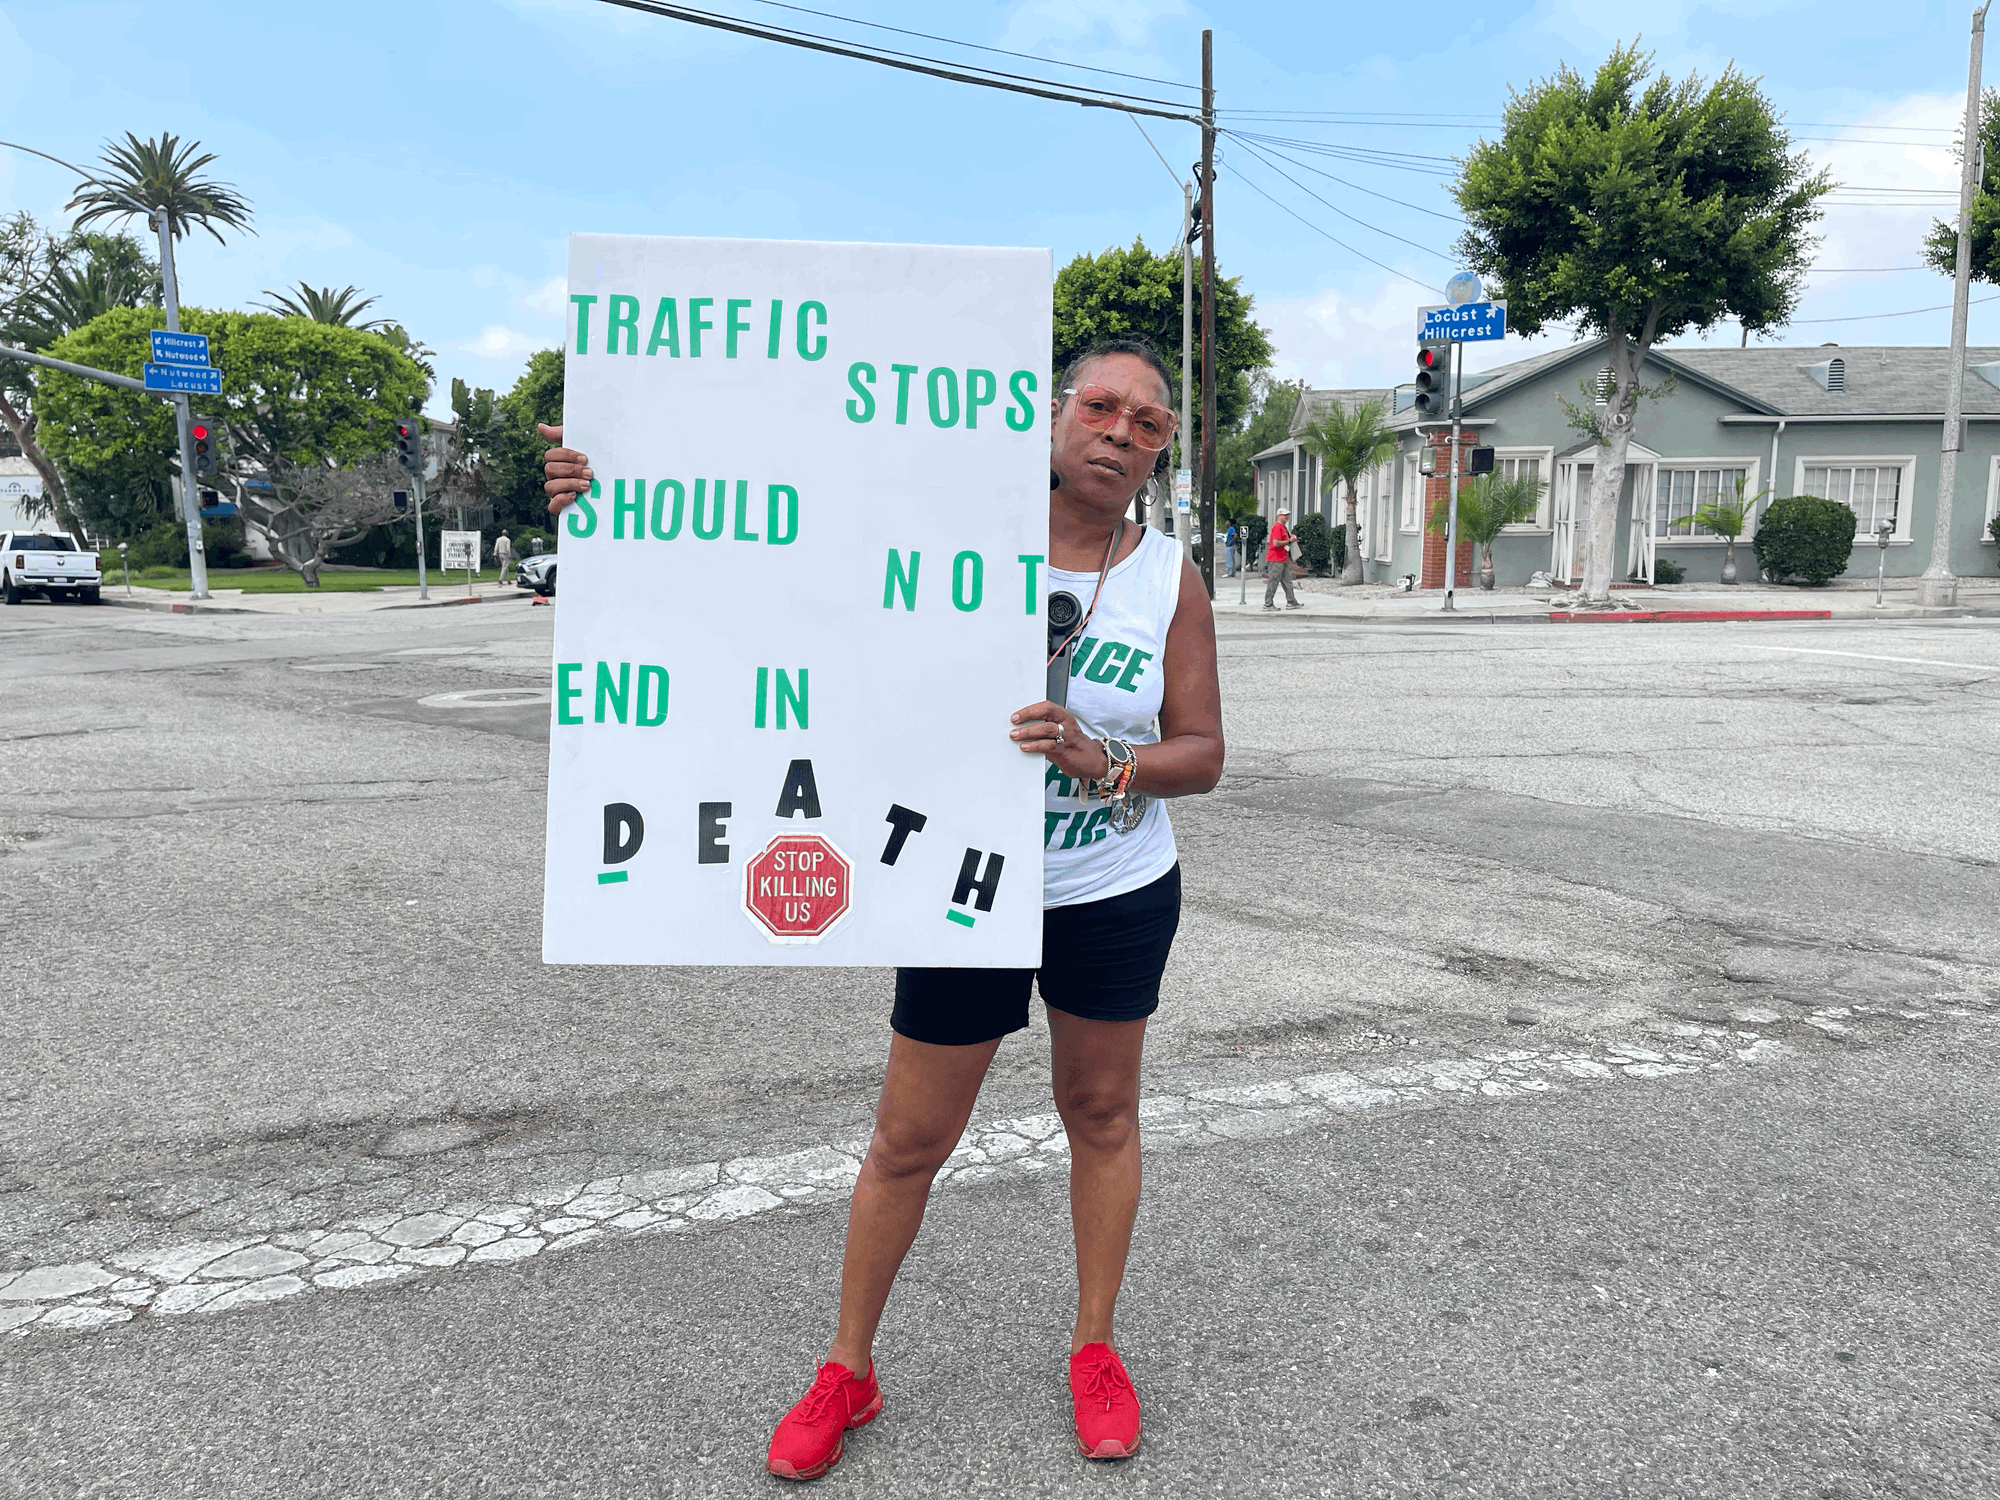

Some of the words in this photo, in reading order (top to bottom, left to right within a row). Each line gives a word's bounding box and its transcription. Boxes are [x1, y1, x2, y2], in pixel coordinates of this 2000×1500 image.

[1425, 308, 1477, 324] Locust
[570, 294, 827, 361] TRAFFIC
[1424, 323, 1492, 340] Hillcrest
[163, 337, 197, 348] Hillcrest
[165, 350, 198, 361] Nutwood
[160, 368, 207, 379] Nutwood
[171, 380, 207, 390] Locust
[846, 362, 1037, 431] STOPS
[567, 478, 798, 545] SHOULD
[883, 548, 1044, 615] NOT
[558, 661, 669, 726] END
[754, 667, 808, 729] IN
[603, 759, 1005, 912] DEATH
[773, 851, 825, 872] STOP
[760, 876, 837, 898] KILLING
[785, 901, 811, 923] US
